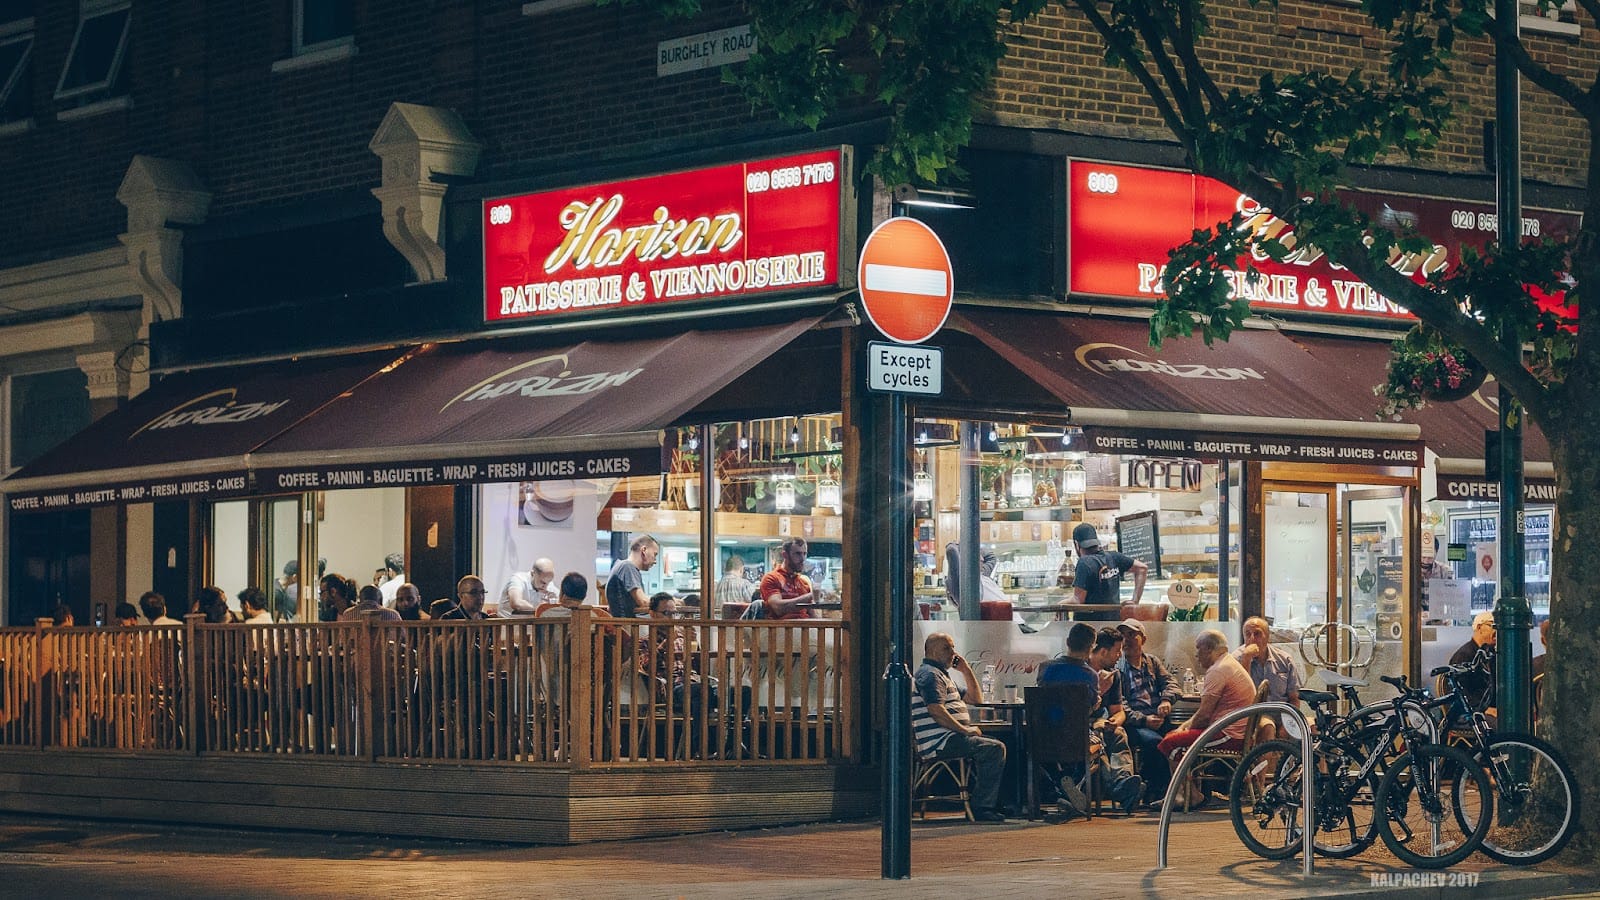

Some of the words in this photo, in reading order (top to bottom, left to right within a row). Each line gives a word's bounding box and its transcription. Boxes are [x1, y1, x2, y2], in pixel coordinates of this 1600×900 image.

[661, 40, 717, 65] BURGHLEY
[723, 33, 753, 53] ROAD
[747, 171, 770, 193] 020
[771, 166, 801, 189] 8558
[802, 162, 834, 185] 7178
[1088, 172, 1118, 193] 809
[490, 204, 512, 225] 809
[1452, 210, 1475, 229] 020
[1520, 217, 1540, 237] 178
[543, 193, 743, 274] Horizon
[500, 275, 622, 315] PATISSERIE
[626, 272, 646, 302] &
[650, 251, 825, 298] VIENNOISERIE
[1304, 278, 1327, 307] &
[880, 350, 931, 371] Except
[883, 371, 929, 388] cycles
[1096, 436, 1138, 449] COFFEE
[1147, 439, 1185, 451] PANINI
[1194, 441, 1251, 454] BAGUETTE
[1260, 444, 1291, 456] WRAP
[1300, 446, 1335, 458] FRESH
[1337, 447, 1374, 460] JUICES
[1383, 449, 1418, 461] CAKES
[278, 473, 319, 488] COFFEE
[327, 470, 364, 486] PANINI
[373, 467, 434, 484] BAGUETTE
[443, 464, 478, 480] WRAP
[488, 462, 526, 478] FRESH
[529, 460, 575, 476] JUICES
[586, 457, 631, 474] CAKES
[11, 497, 39, 510] COFFEE
[44, 494, 69, 507] PANINI
[75, 489, 115, 504] BAGUETTE
[121, 485, 145, 500] WRAP
[151, 484, 178, 497] FRESH
[180, 480, 210, 495] JUICES
[216, 477, 245, 490] CAKES
[1449, 481, 1499, 498] COFFE
